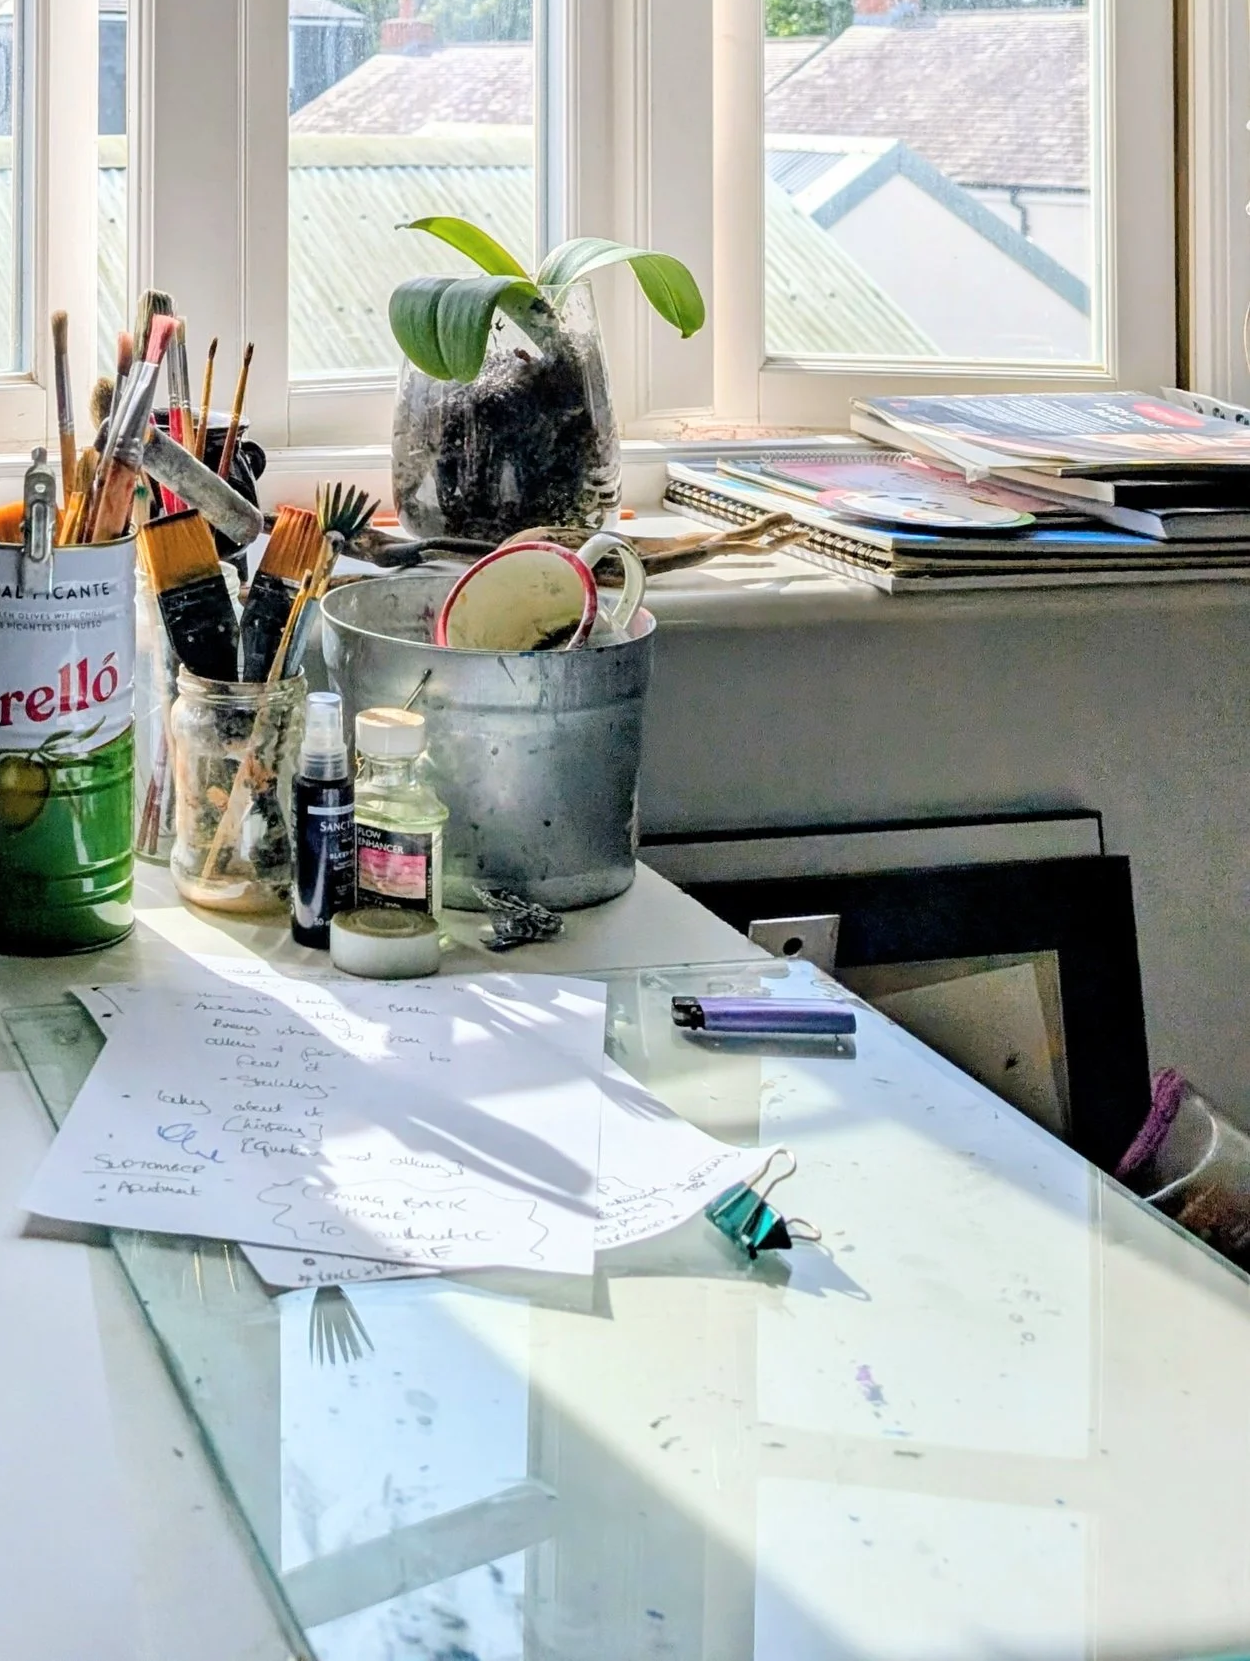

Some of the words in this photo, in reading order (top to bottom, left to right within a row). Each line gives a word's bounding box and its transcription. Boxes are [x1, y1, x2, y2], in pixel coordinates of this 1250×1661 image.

[357, 827, 382, 840] FLOW
[357, 837, 405, 855] ENHANCER
[402, 1197, 468, 1212] BACK
[307, 1220, 347, 1237] TO
